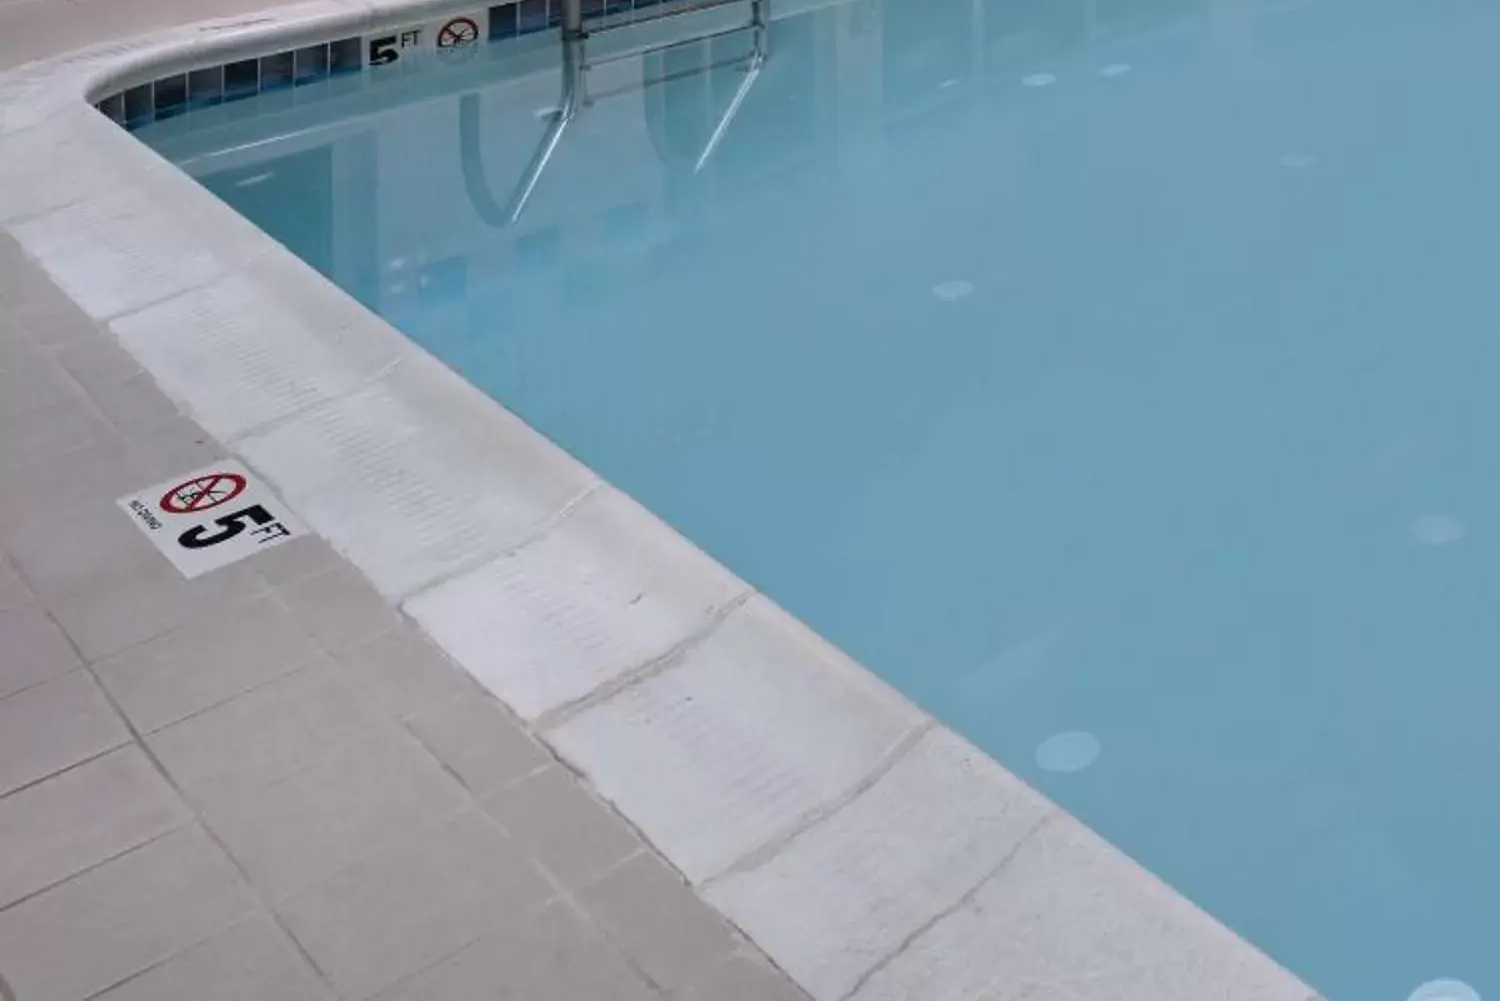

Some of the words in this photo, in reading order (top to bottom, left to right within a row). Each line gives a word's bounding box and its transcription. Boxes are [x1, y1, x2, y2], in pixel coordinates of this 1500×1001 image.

[368, 35, 399, 66] 5
[400, 29, 424, 48] FT
[177, 504, 275, 550] 5
[250, 521, 291, 544] FT
